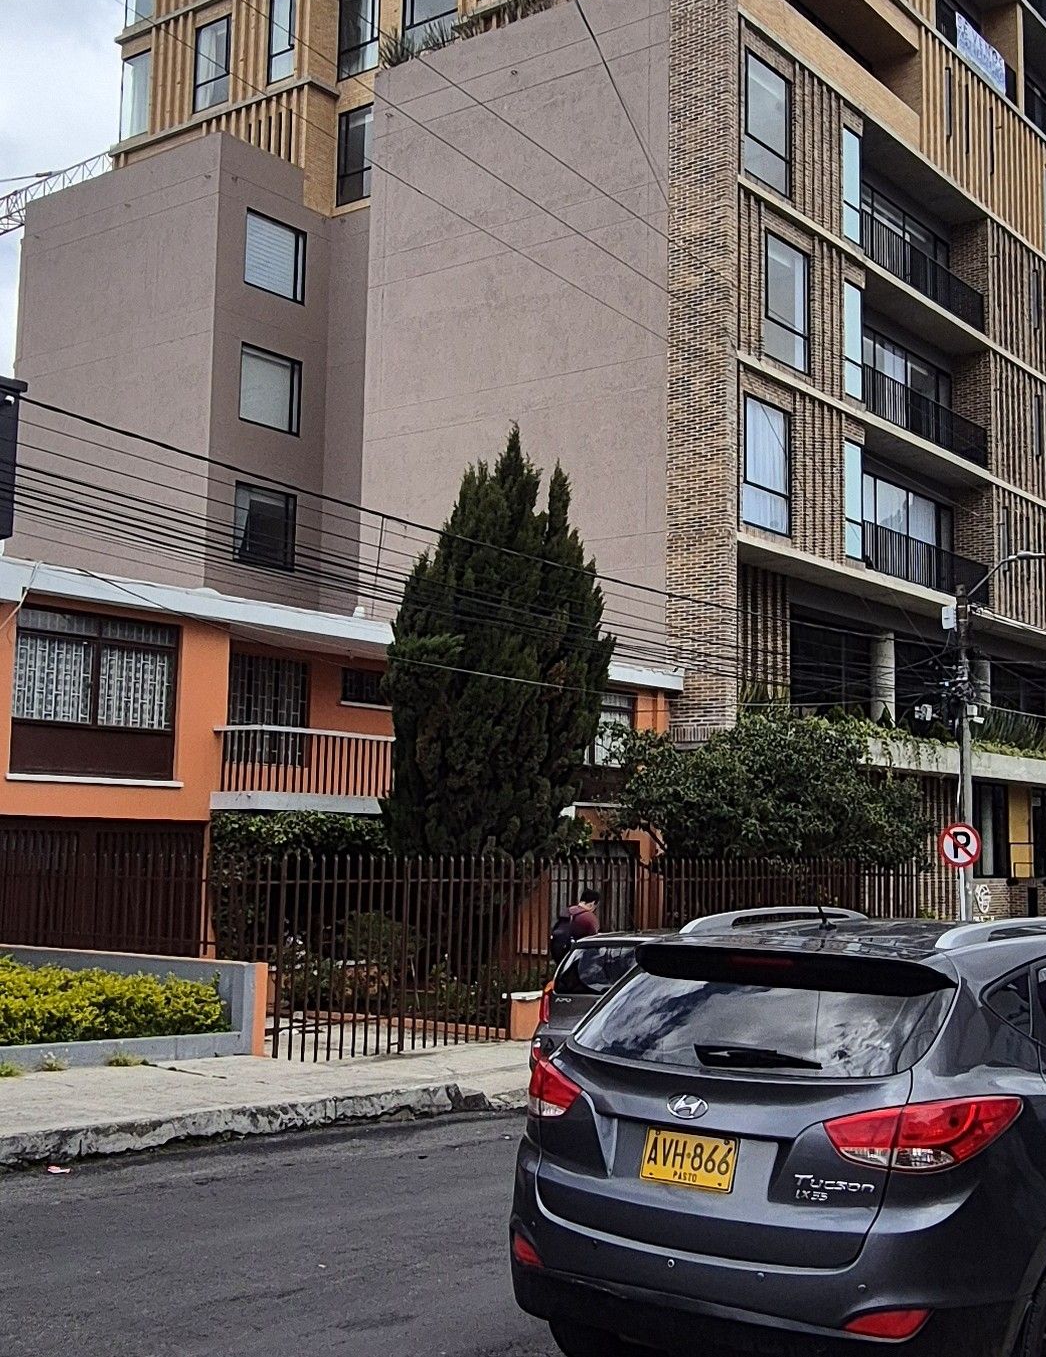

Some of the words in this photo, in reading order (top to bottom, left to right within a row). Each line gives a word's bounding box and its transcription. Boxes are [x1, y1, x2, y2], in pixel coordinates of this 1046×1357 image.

[952, 831, 971, 859] P
[672, 1169, 698, 1183] PASTO
[794, 1173, 875, 1193] Tucson
